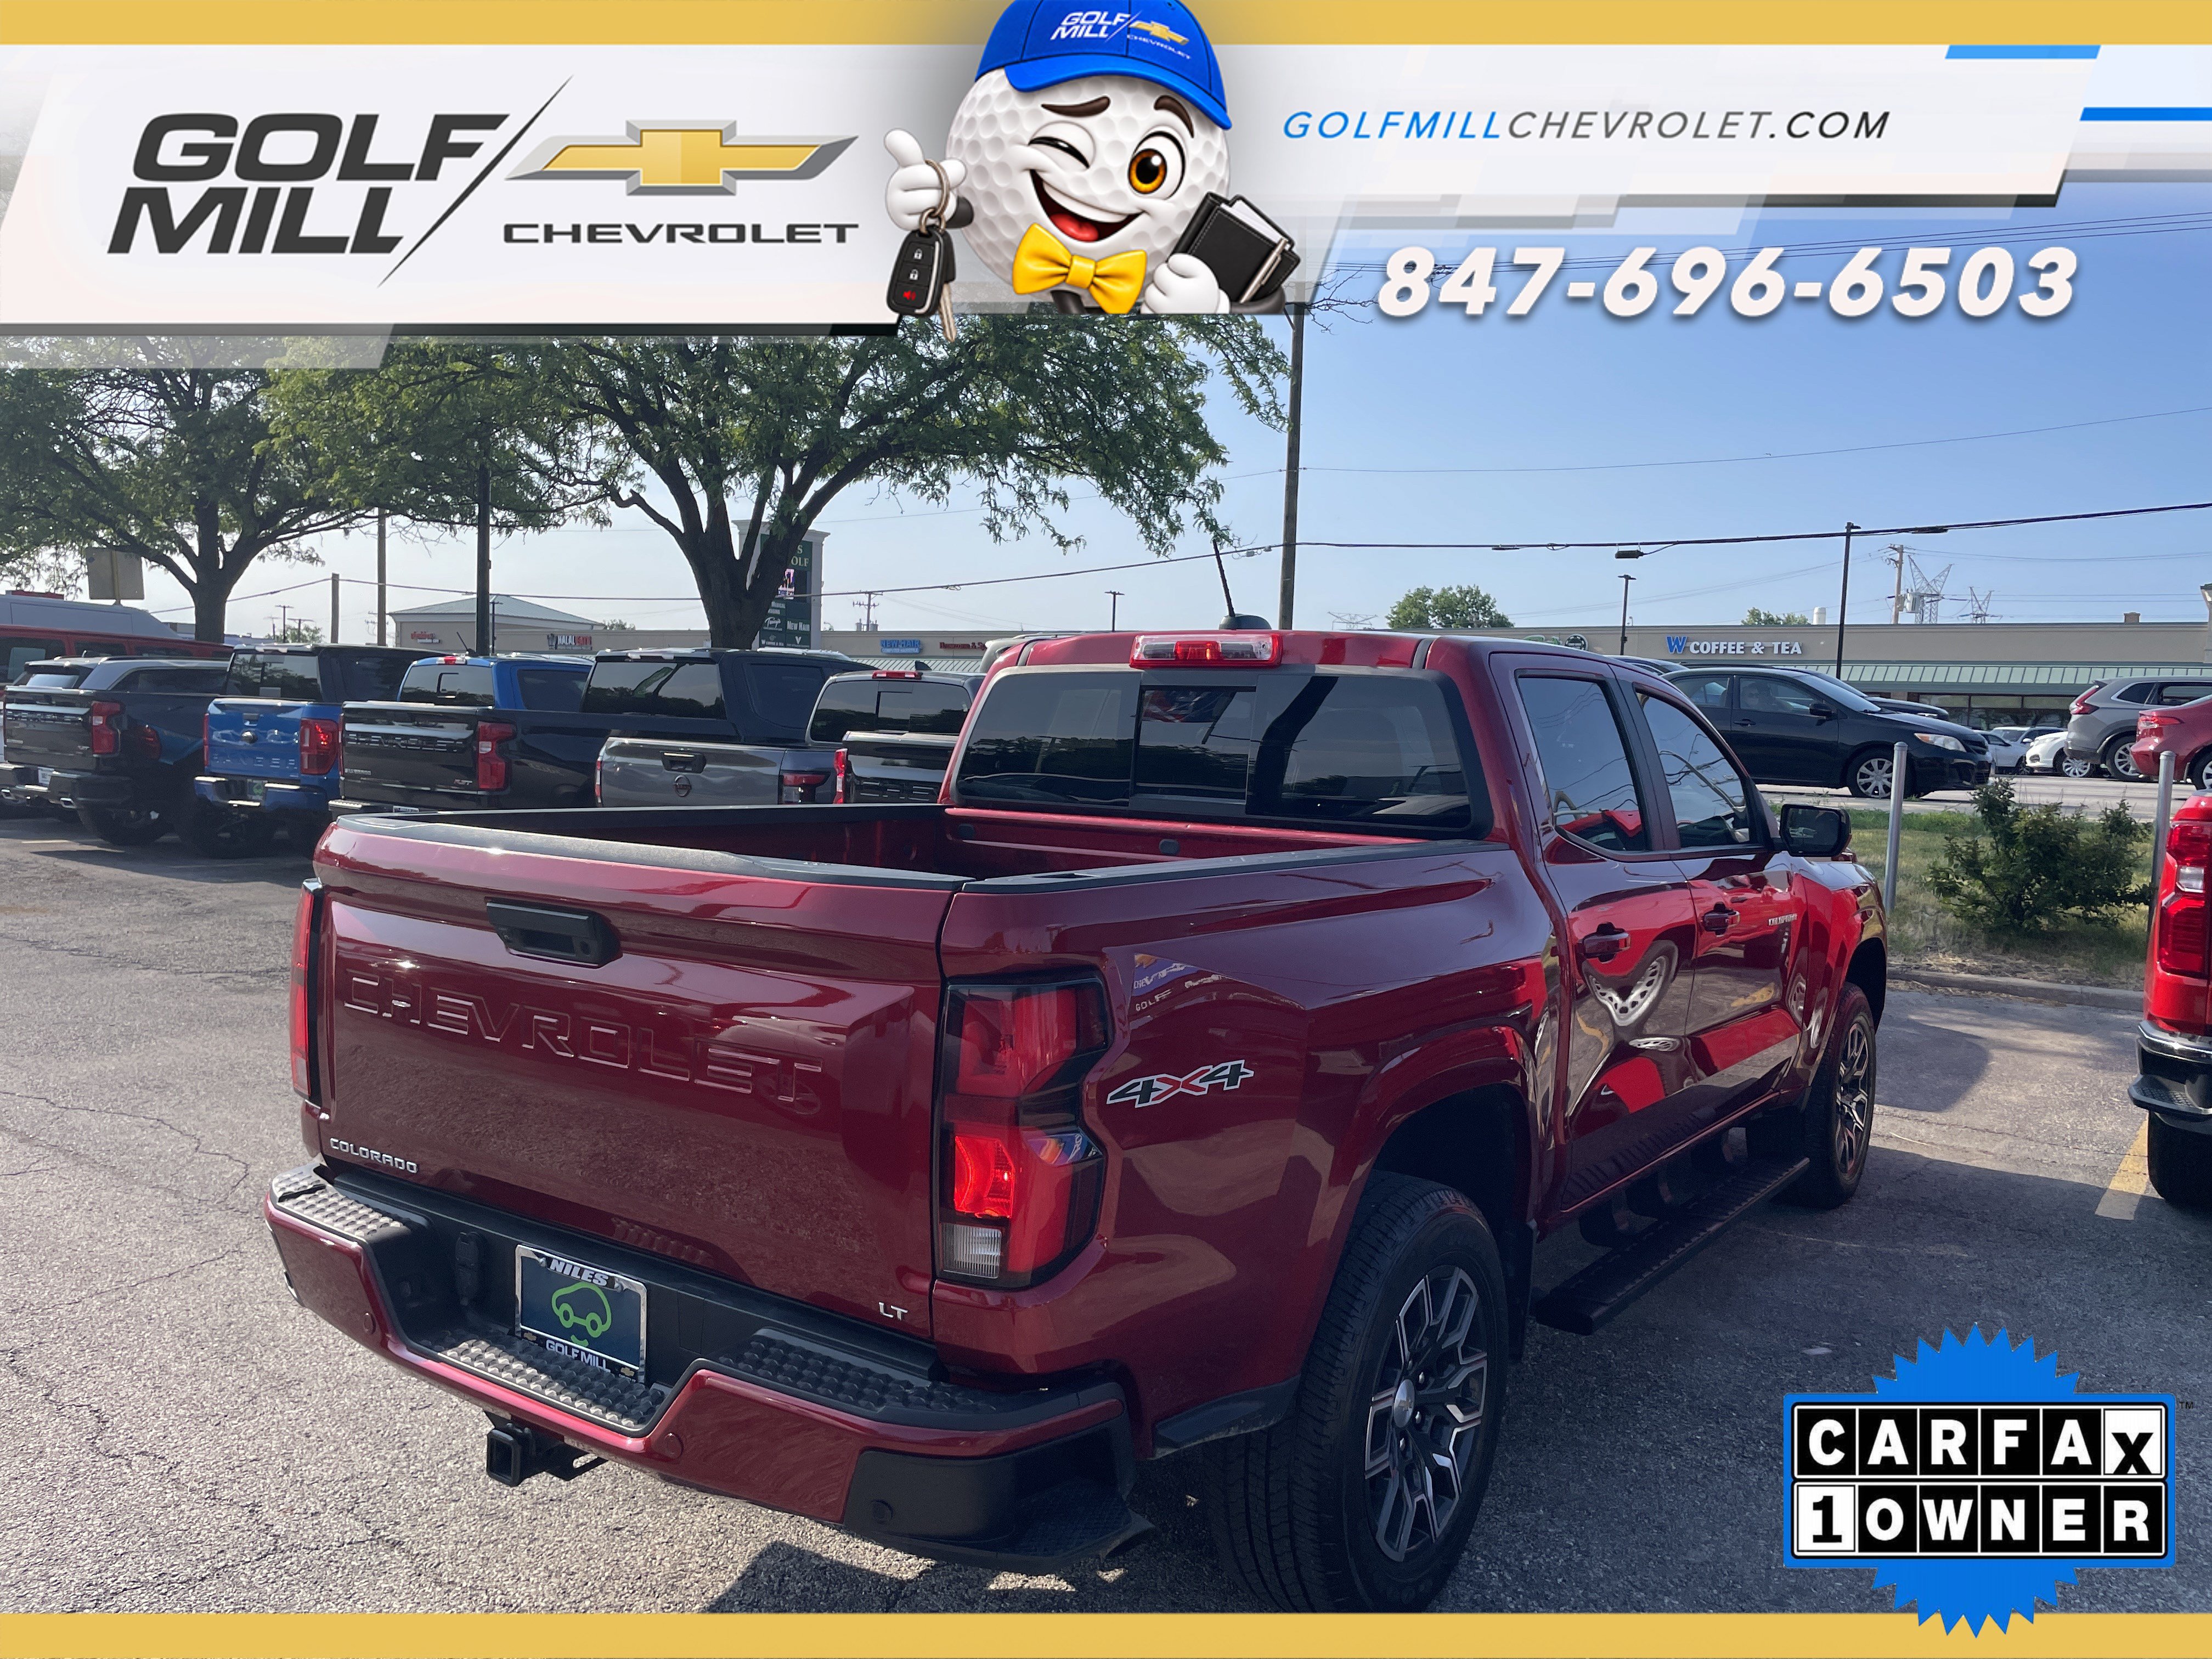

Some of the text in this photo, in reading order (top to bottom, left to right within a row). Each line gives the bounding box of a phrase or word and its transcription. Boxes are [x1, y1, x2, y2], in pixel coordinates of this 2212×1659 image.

[791, 556, 809, 567] OLF
[1666, 635, 1802, 654] W COFFEE & TEA
[343, 969, 823, 1102] CHEVROLET
[329, 1137, 419, 1174] COLORADO
[550, 1259, 609, 1286] NILES
[879, 1301, 908, 1321] LT
[546, 1339, 611, 1372] GOLF MILL
